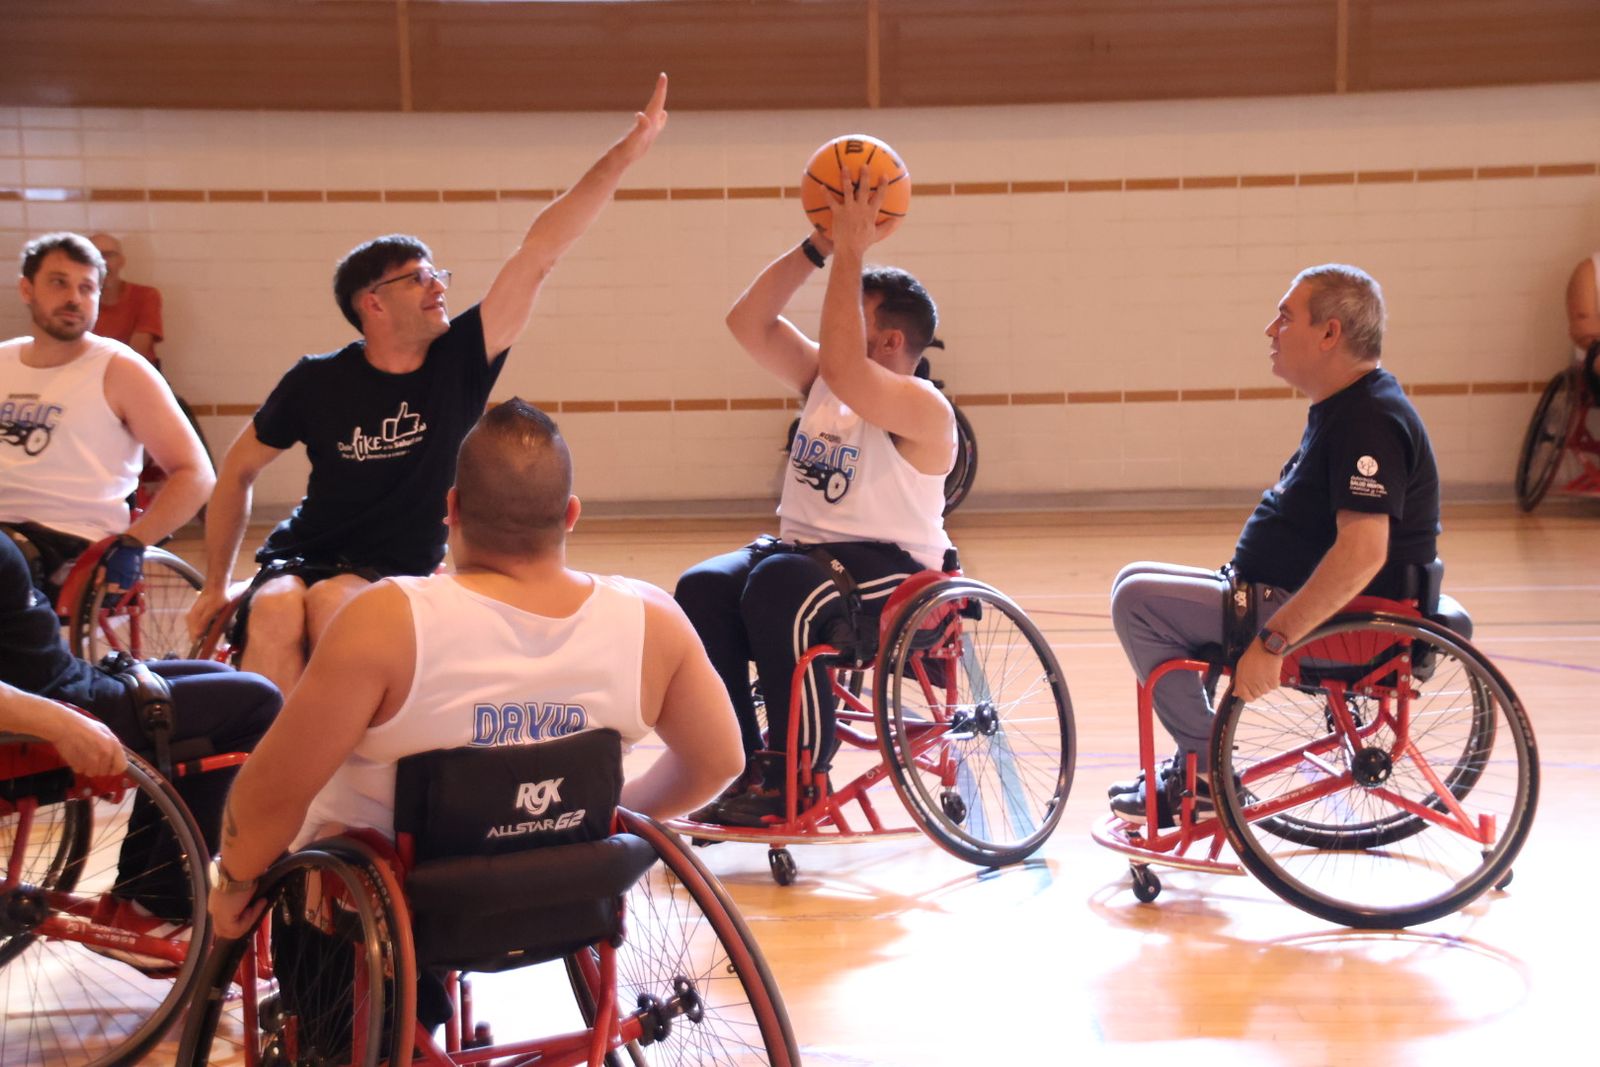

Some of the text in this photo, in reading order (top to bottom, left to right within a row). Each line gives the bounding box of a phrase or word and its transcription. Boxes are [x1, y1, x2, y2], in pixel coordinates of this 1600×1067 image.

[0, 401, 64, 431] AGIC
[472, 702, 588, 747] DAVID
[515, 777, 565, 816] RGK
[486, 818, 555, 839] ALLSTAR
